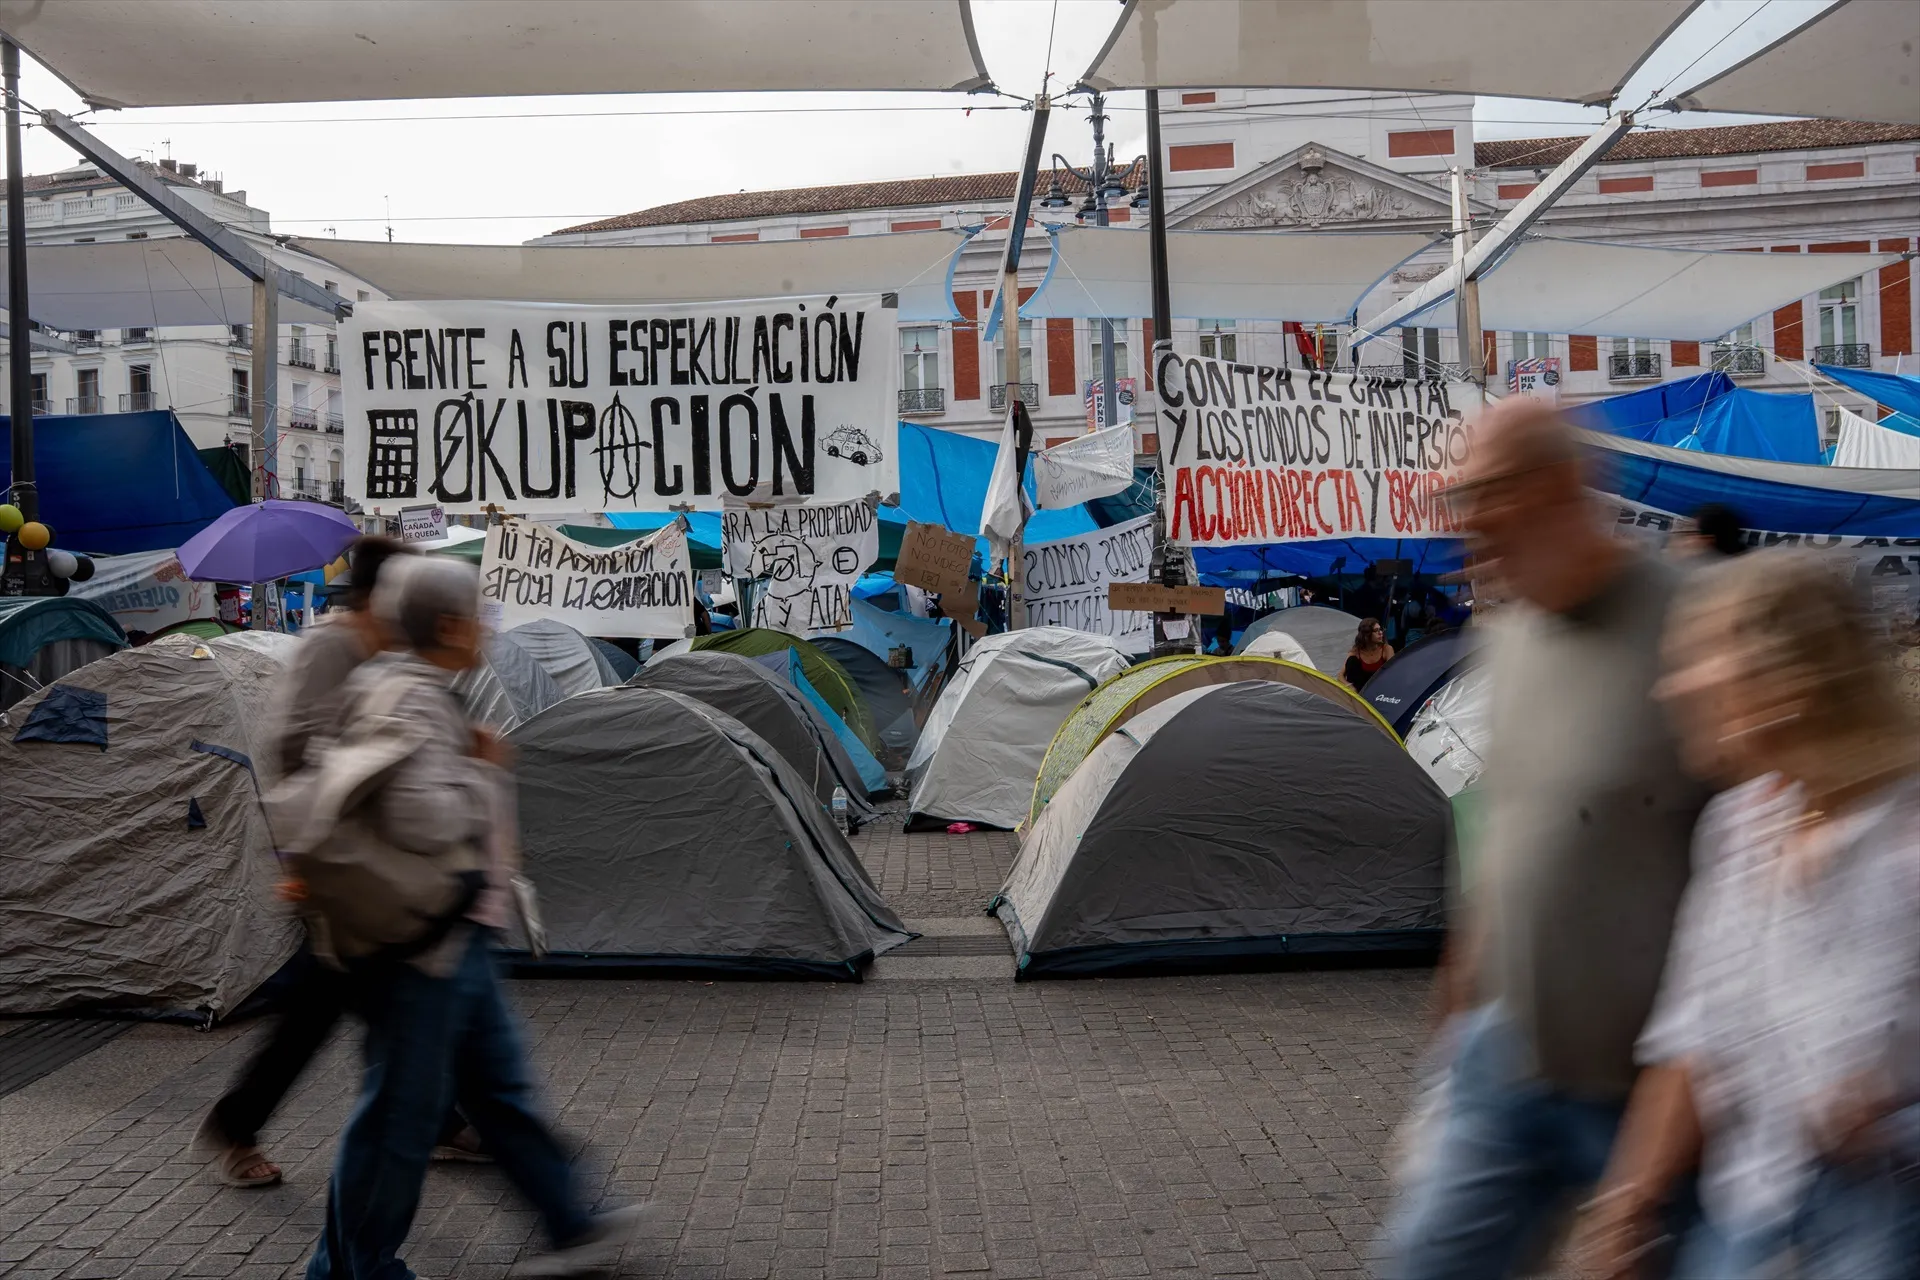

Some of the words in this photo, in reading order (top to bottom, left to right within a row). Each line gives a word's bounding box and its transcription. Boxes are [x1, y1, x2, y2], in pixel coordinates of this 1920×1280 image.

[362, 328, 488, 390] FRENTE
[508, 328, 529, 388] A
[546, 321, 588, 388] SU
[608, 295, 865, 387] ESPEKULACIÓN
[1158, 352, 1296, 409] CONTRA
[1308, 371, 1342, 403] EL
[1349, 375, 1462, 419] CAPITAL
[1520, 375, 1536, 383] HIS
[1162, 409, 1188, 466] Y
[1196, 409, 1244, 463] LOS
[1241, 404, 1330, 467] FONDOS
[1340, 408, 1364, 469] DE
[1171, 459, 1268, 542] ACCIÓN
[1265, 465, 1366, 539] DIRECTA
[1363, 469, 1381, 534] Y
[403, 521, 435, 531] CAÑADA
[764, 509, 792, 533] LA
[799, 502, 873, 538] PROPIEDAD
[404, 532, 413, 540] SE
[414, 530, 440, 539] QUEDA
[916, 532, 937, 549] NO
[911, 548, 931, 562] NO
[934, 556, 969, 577] VIDEOS
[779, 603, 792, 628] Y
